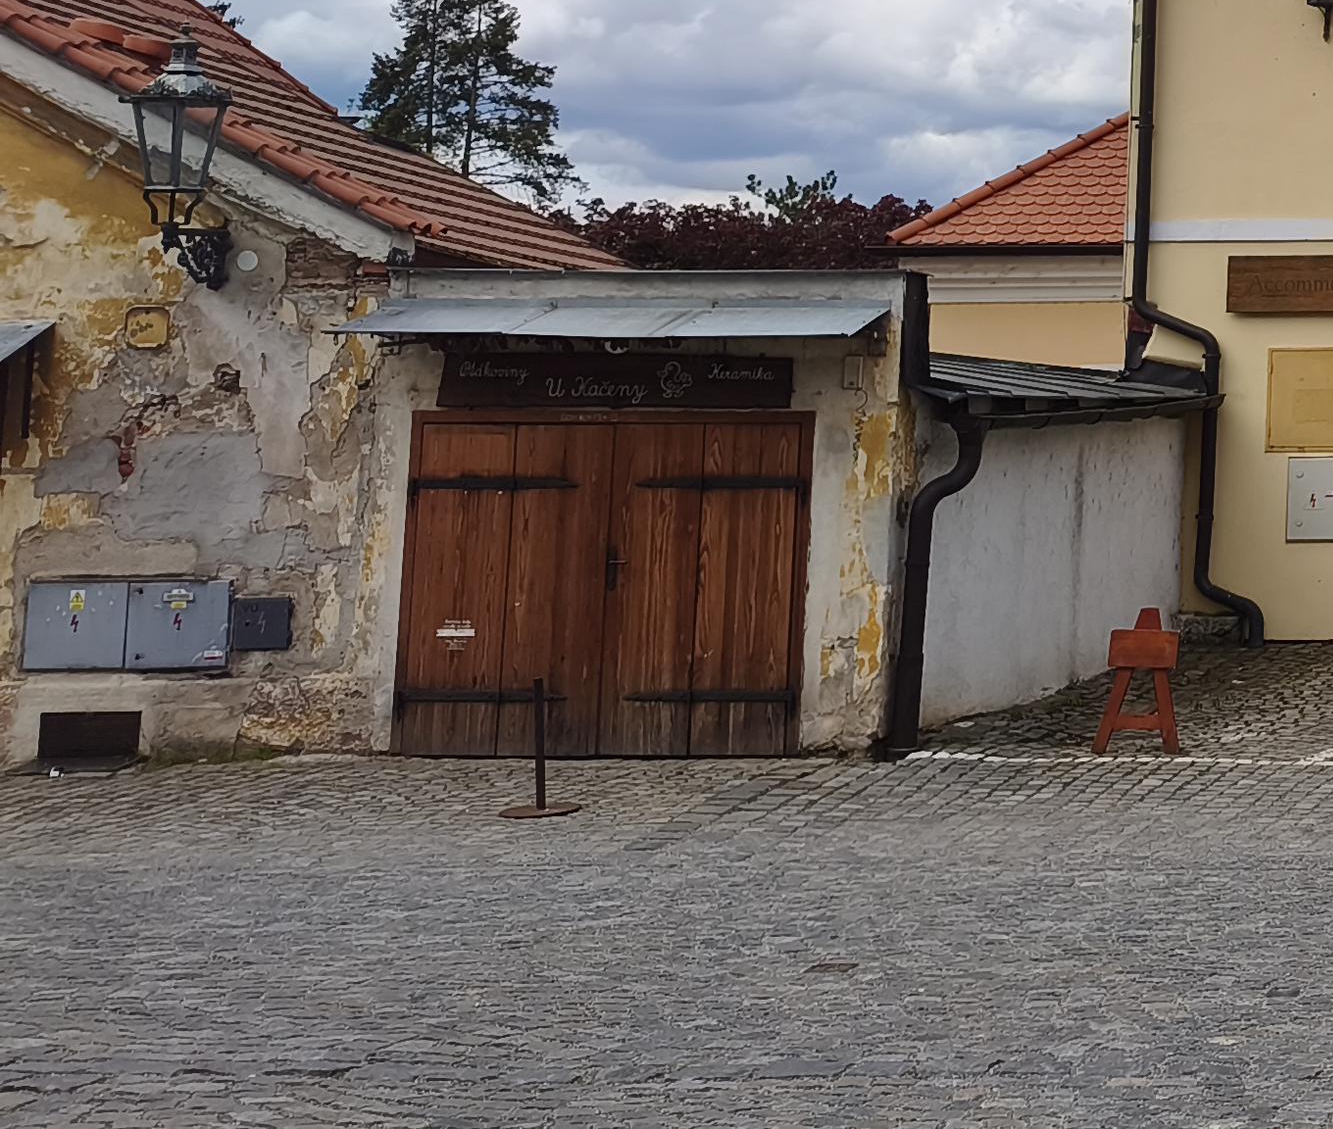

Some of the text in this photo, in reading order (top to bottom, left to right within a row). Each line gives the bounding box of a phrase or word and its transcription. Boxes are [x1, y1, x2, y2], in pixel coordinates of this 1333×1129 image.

[707, 362, 775, 381] Keramika
[545, 376, 649, 404] U Kačeny
